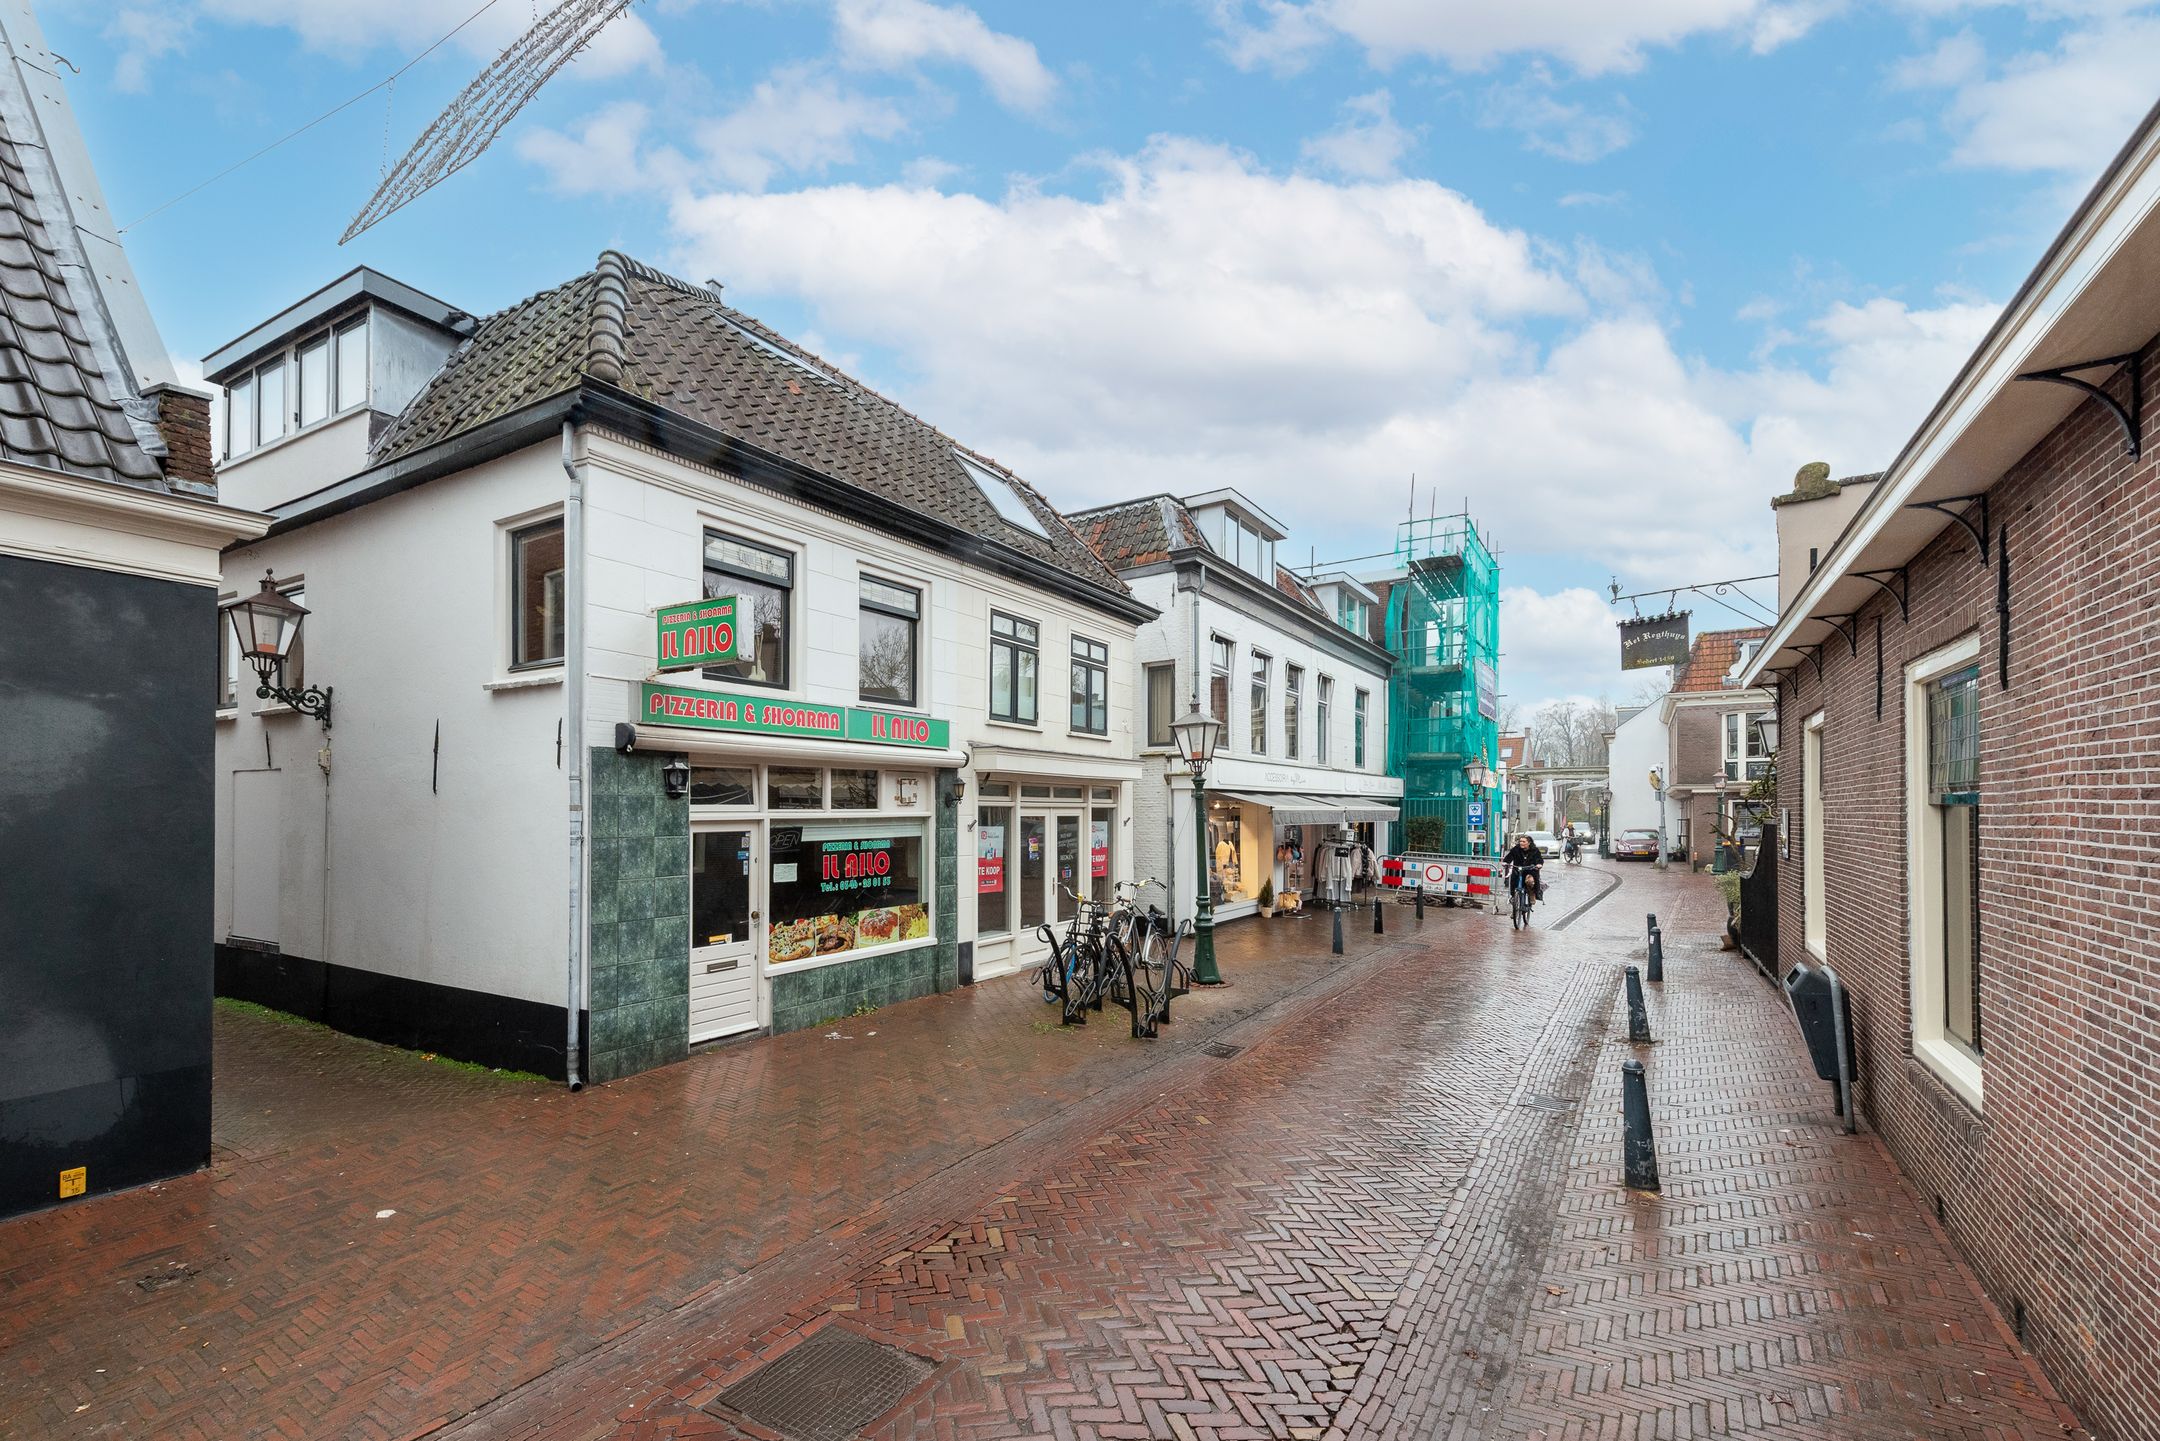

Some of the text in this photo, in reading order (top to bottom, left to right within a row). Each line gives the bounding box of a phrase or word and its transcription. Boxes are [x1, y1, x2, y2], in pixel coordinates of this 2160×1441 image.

[662, 605, 732, 625] PIZZERIA & SHOARMA
[662, 622, 733, 660] IL NILO
[650, 692, 840, 731] PIZZERIA & SHOARMA
[872, 713, 930, 742] IL NILO
[823, 854, 840, 880] IL
[844, 850, 891, 878] NILO
